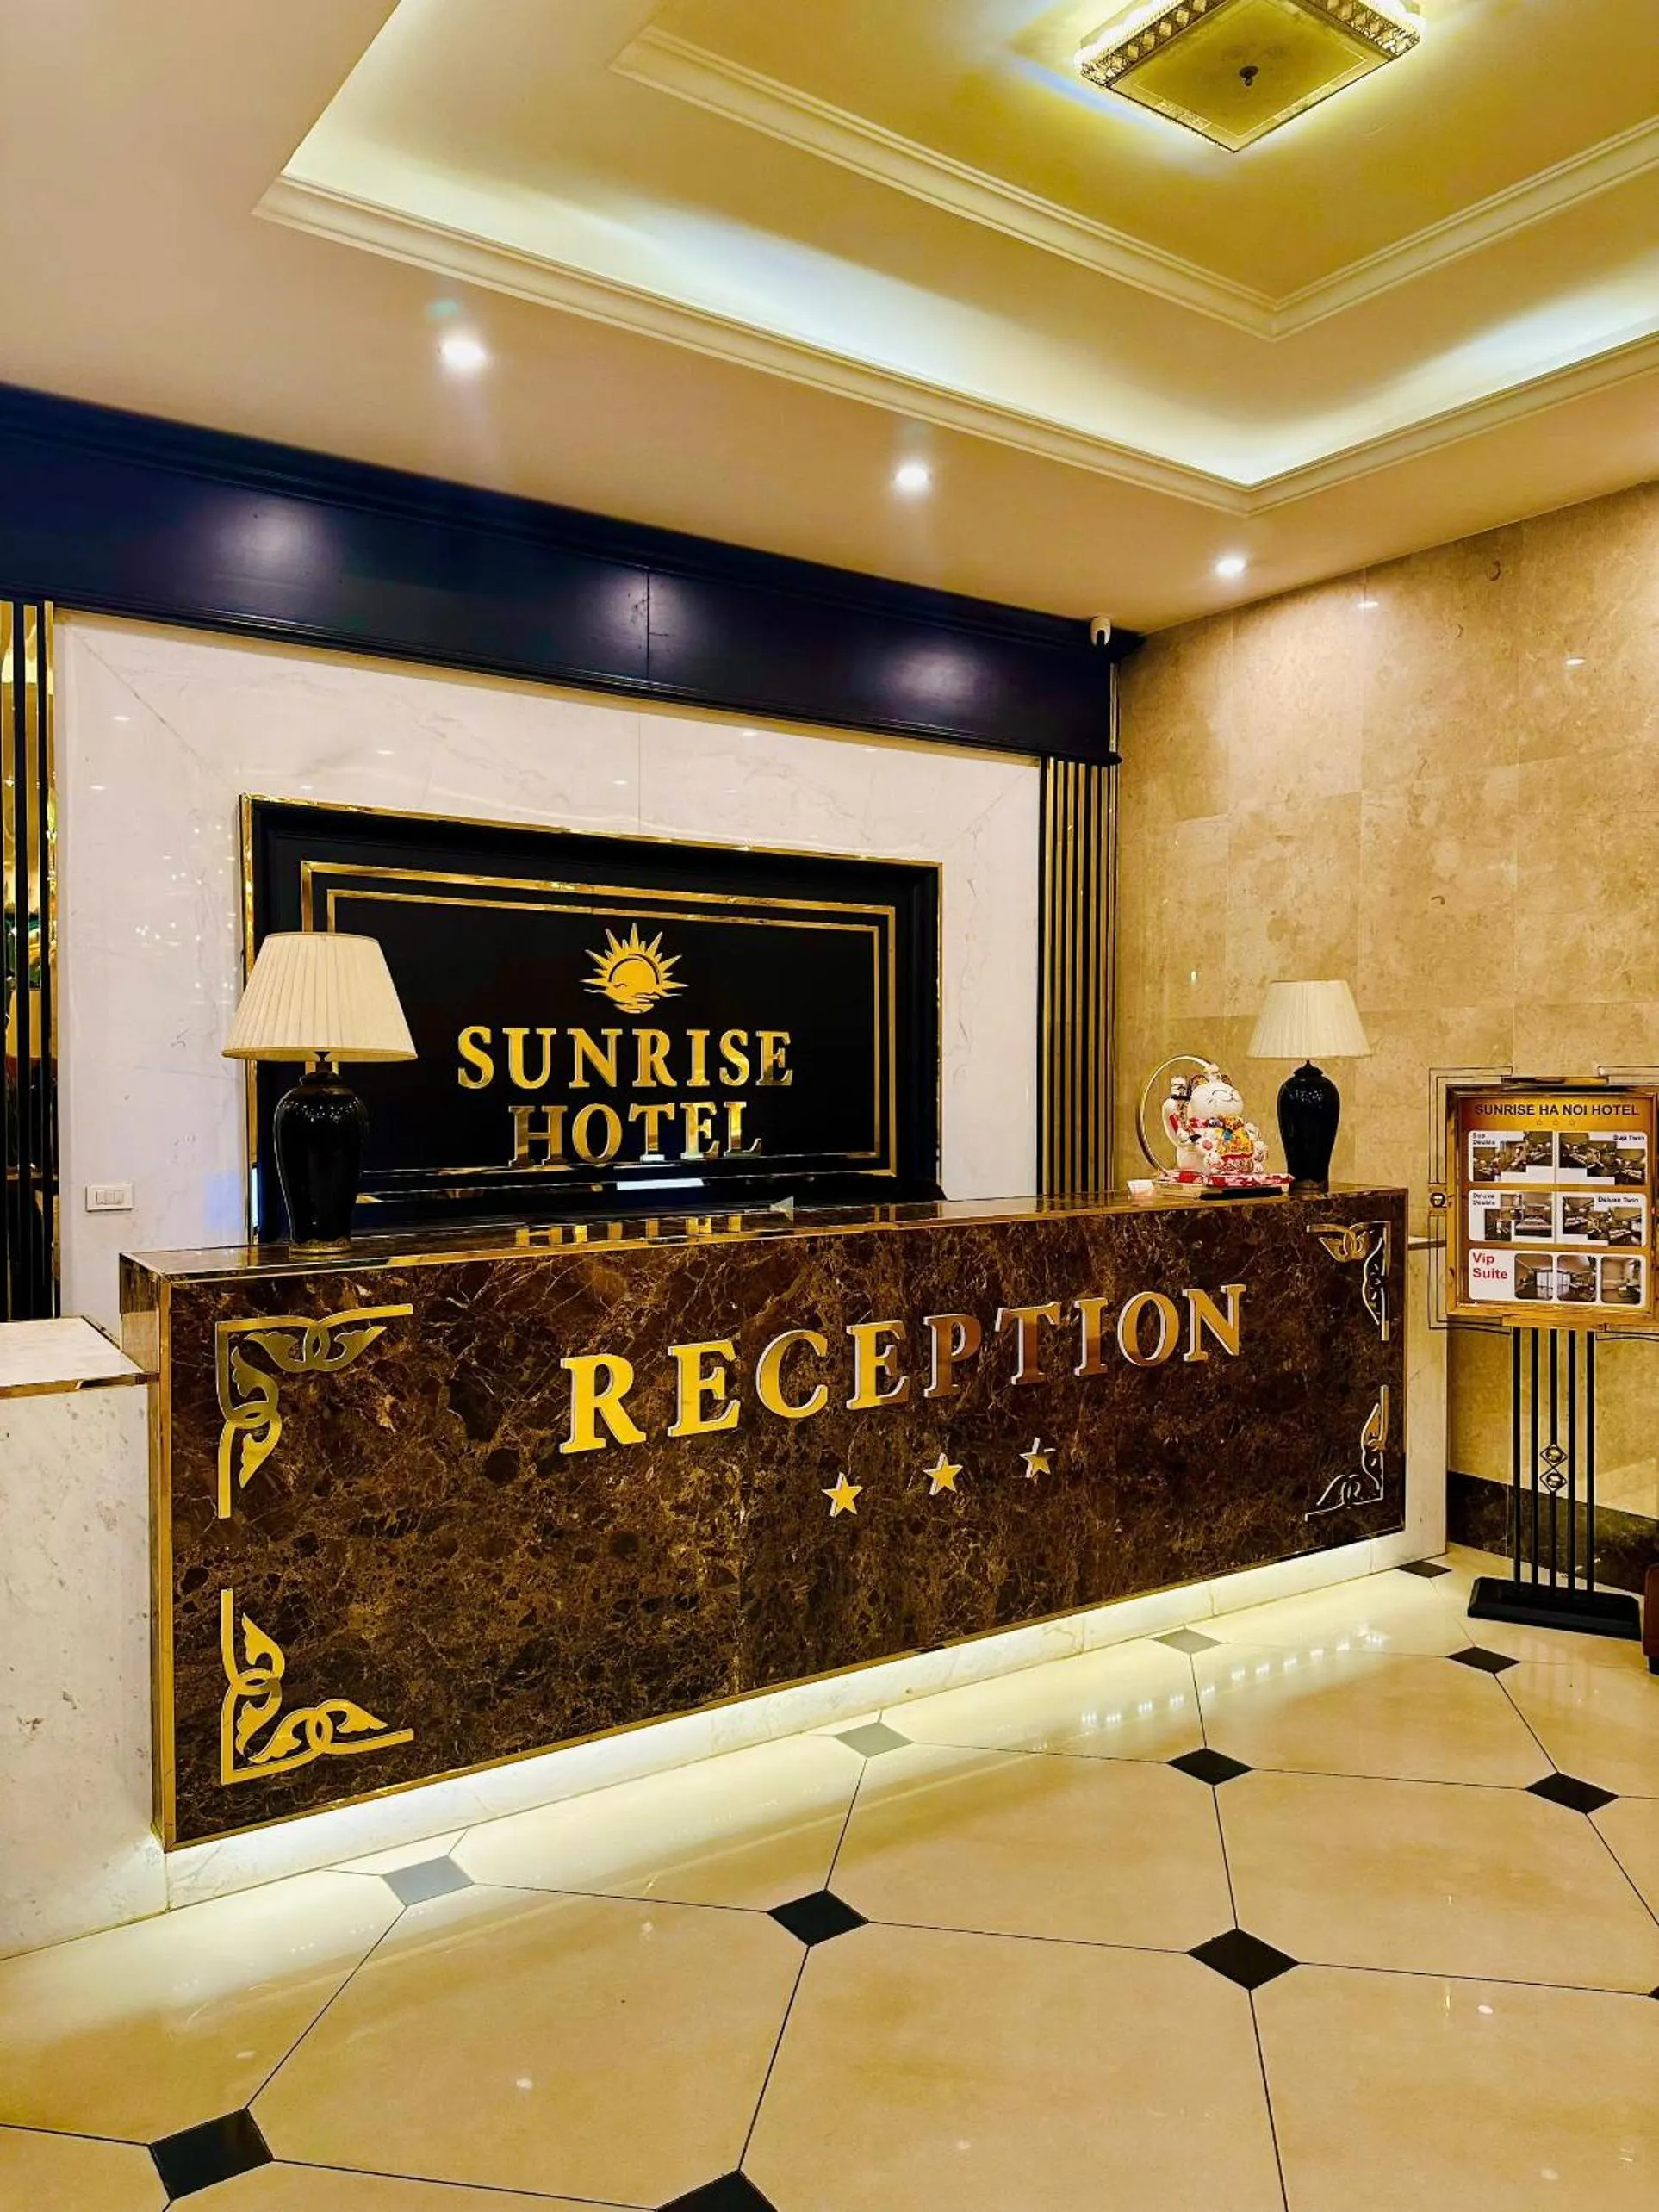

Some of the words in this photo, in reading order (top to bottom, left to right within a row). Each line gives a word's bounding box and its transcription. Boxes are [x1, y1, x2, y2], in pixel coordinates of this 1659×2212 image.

[457, 1025, 792, 1089] SUNRISE
[1475, 1104, 1534, 1115] SUNRISE
[1539, 1104, 1559, 1115] HA
[1563, 1104, 1587, 1115] NOI
[1592, 1104, 1640, 1115] HOTEL
[508, 1101, 762, 1168] HOTEL
[1473, 1252, 1494, 1265] Vip
[1473, 1268, 1508, 1279] Suite
[559, 1283, 1246, 1454] RECEPTION
